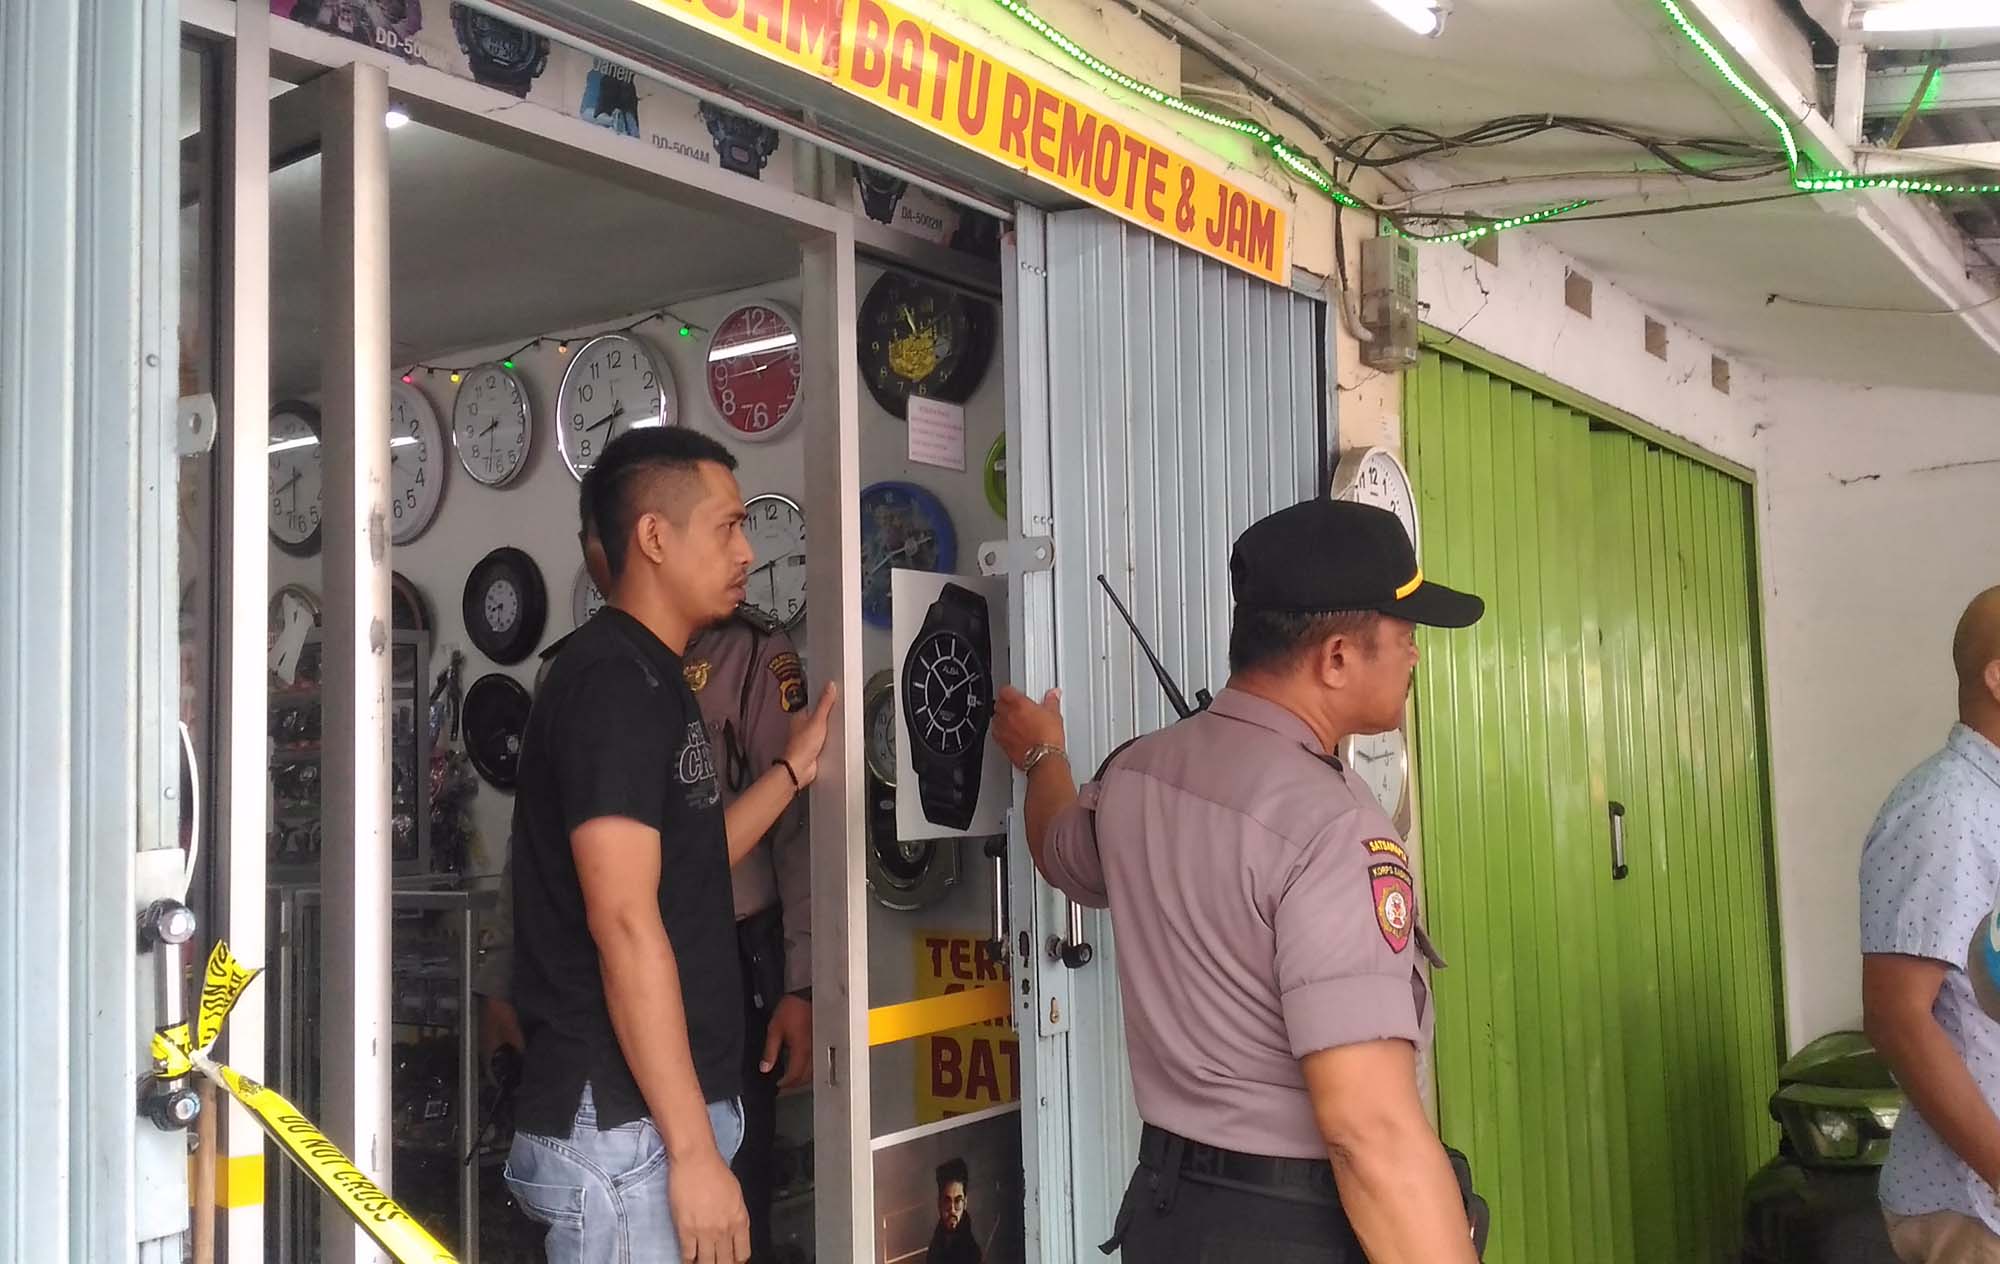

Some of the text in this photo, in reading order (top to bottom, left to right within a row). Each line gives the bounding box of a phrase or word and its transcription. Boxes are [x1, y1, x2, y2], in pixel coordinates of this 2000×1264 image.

[851, 0, 992, 135] BATU
[1000, 72, 1169, 223] REMOTE
[1175, 166, 1196, 233] &
[1205, 183, 1276, 271] JAM
[741, 309, 766, 337] 12
[606, 350, 622, 369] 12
[632, 354, 638, 371] 1
[590, 361, 600, 380] 11
[714, 363, 728, 390] 9
[643, 371, 655, 390] 2
[578, 384, 593, 402] 10
[722, 389, 736, 416] 8
[398, 404, 405, 424] 1
[573, 413, 584, 431] 9
[741, 403, 753, 430] 7
[753, 402, 768, 429] 6
[409, 420, 419, 439] 2
[581, 439, 591, 457] 8
[415, 467, 425, 487] 4
[1369, 467, 1378, 485] 12
[1382, 478, 1387, 496] 1
[406, 489, 416, 508] 5
[393, 500, 402, 518] 6
[765, 504, 777, 520] 12
[788, 508, 792, 525] 1
[788, 599, 798, 614] 5
[300, 1138, 349, 1165] NOT
[334, 1171, 409, 1222] CROSS
